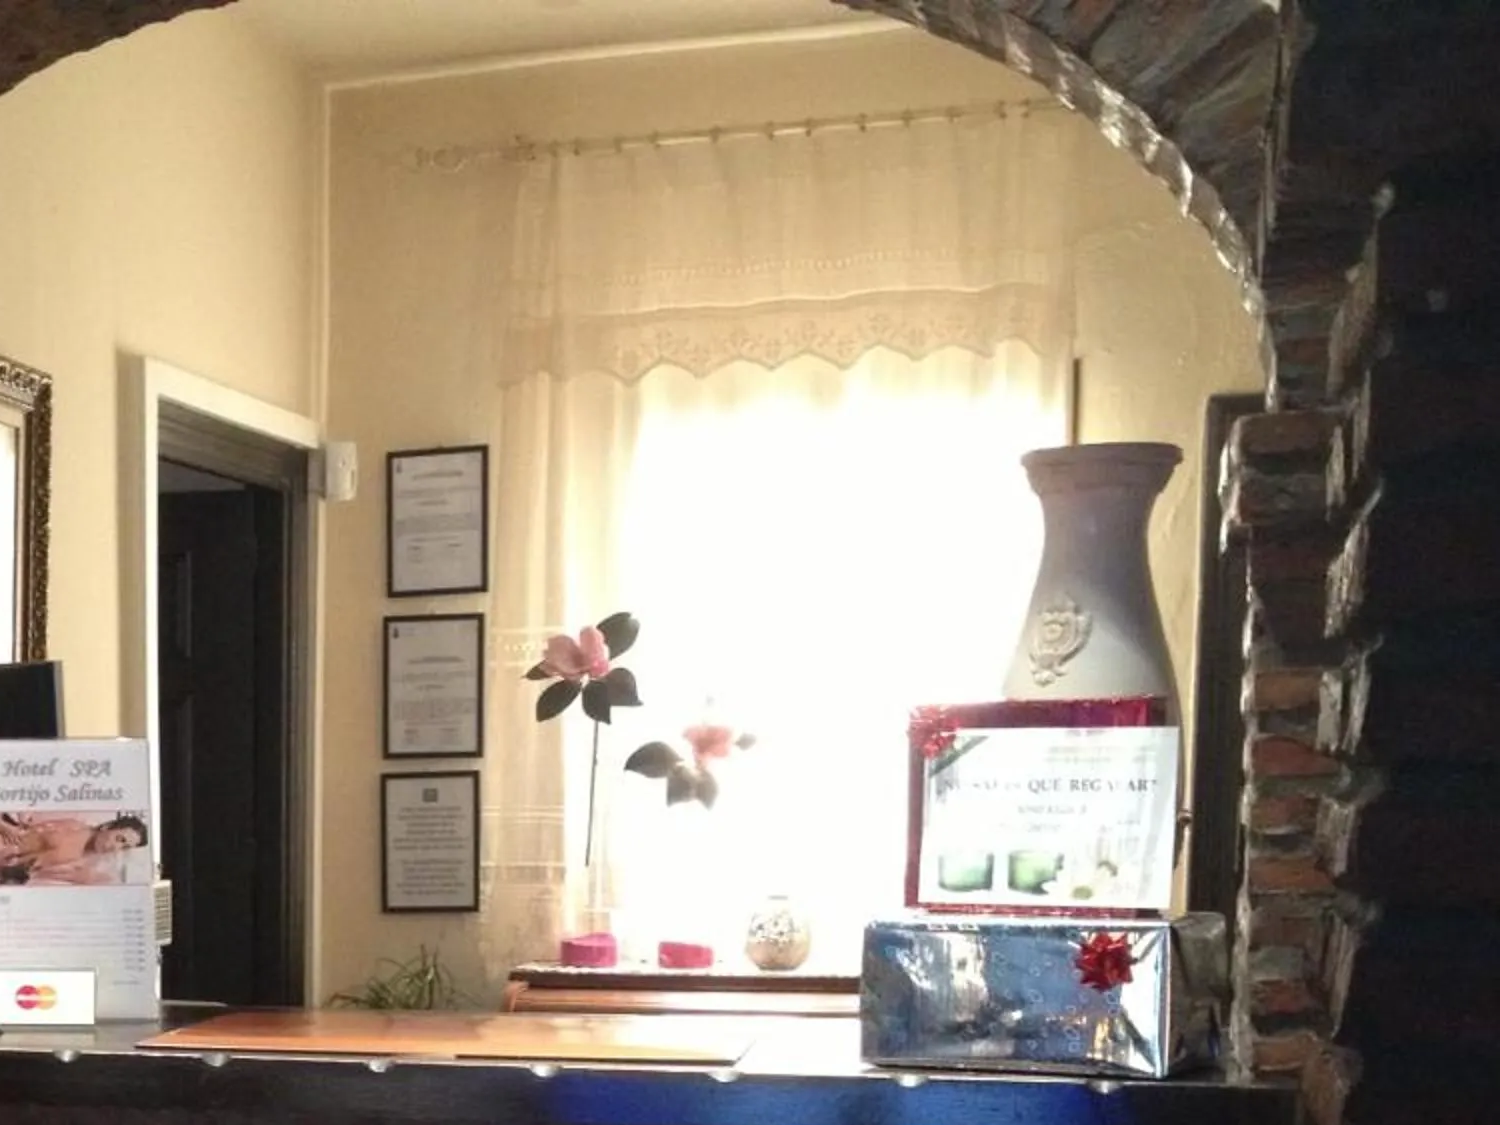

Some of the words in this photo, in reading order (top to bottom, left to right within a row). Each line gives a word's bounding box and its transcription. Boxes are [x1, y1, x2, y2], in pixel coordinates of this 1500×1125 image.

[2, 757, 59, 778] Hotel
[69, 759, 112, 778] SPA
[54, 782, 125, 801] Salinas
